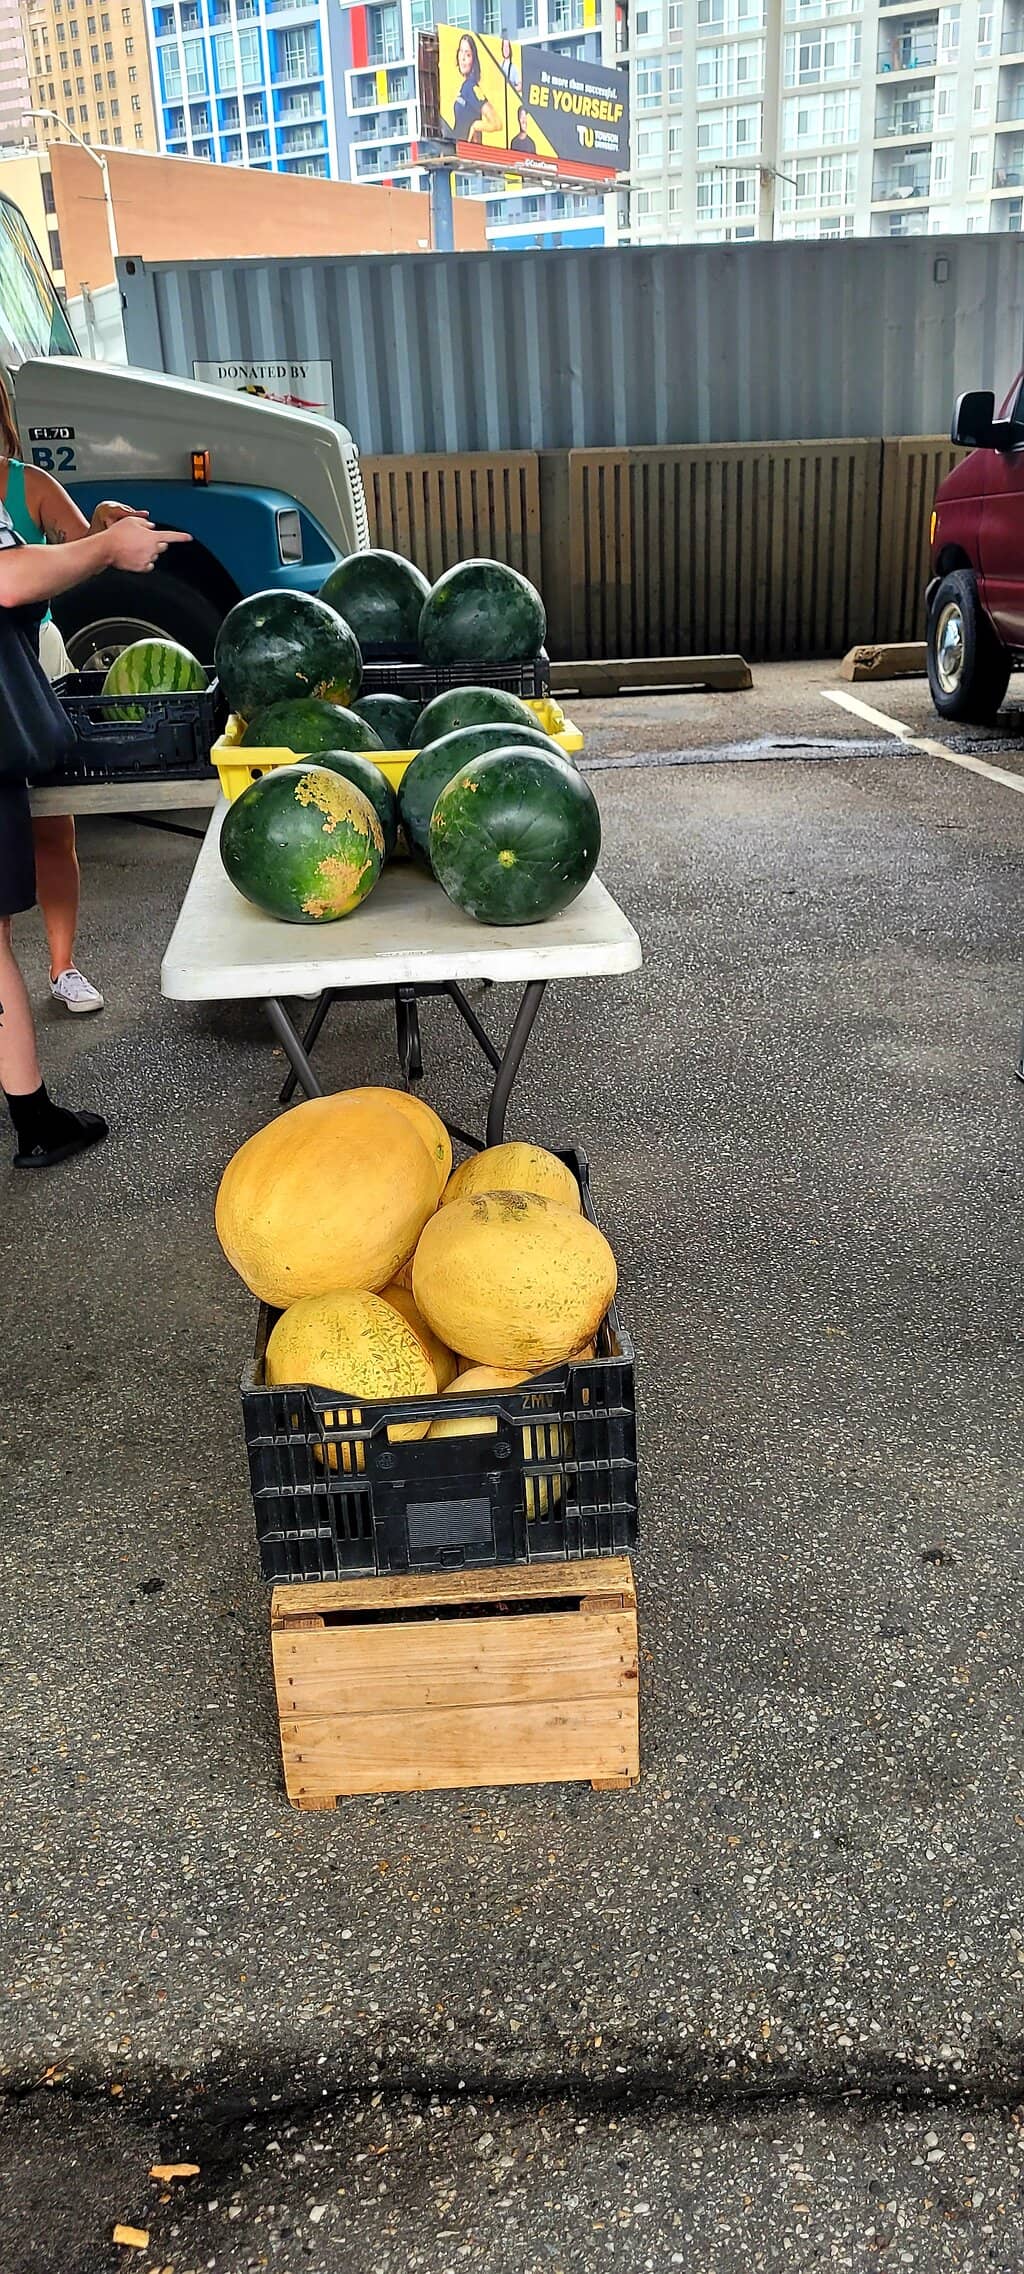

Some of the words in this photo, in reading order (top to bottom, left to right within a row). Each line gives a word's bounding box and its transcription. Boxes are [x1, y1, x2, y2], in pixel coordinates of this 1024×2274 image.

[552, 76, 568, 88] more
[569, 79, 584, 91] than
[529, 85, 549, 107] BE
[552, 90, 623, 122] YOURSELF
[576, 124, 594, 148] TU
[218, 366, 286, 379] DONATED
[291, 366, 309, 378] BY
[32, 447, 76, 471] B2
